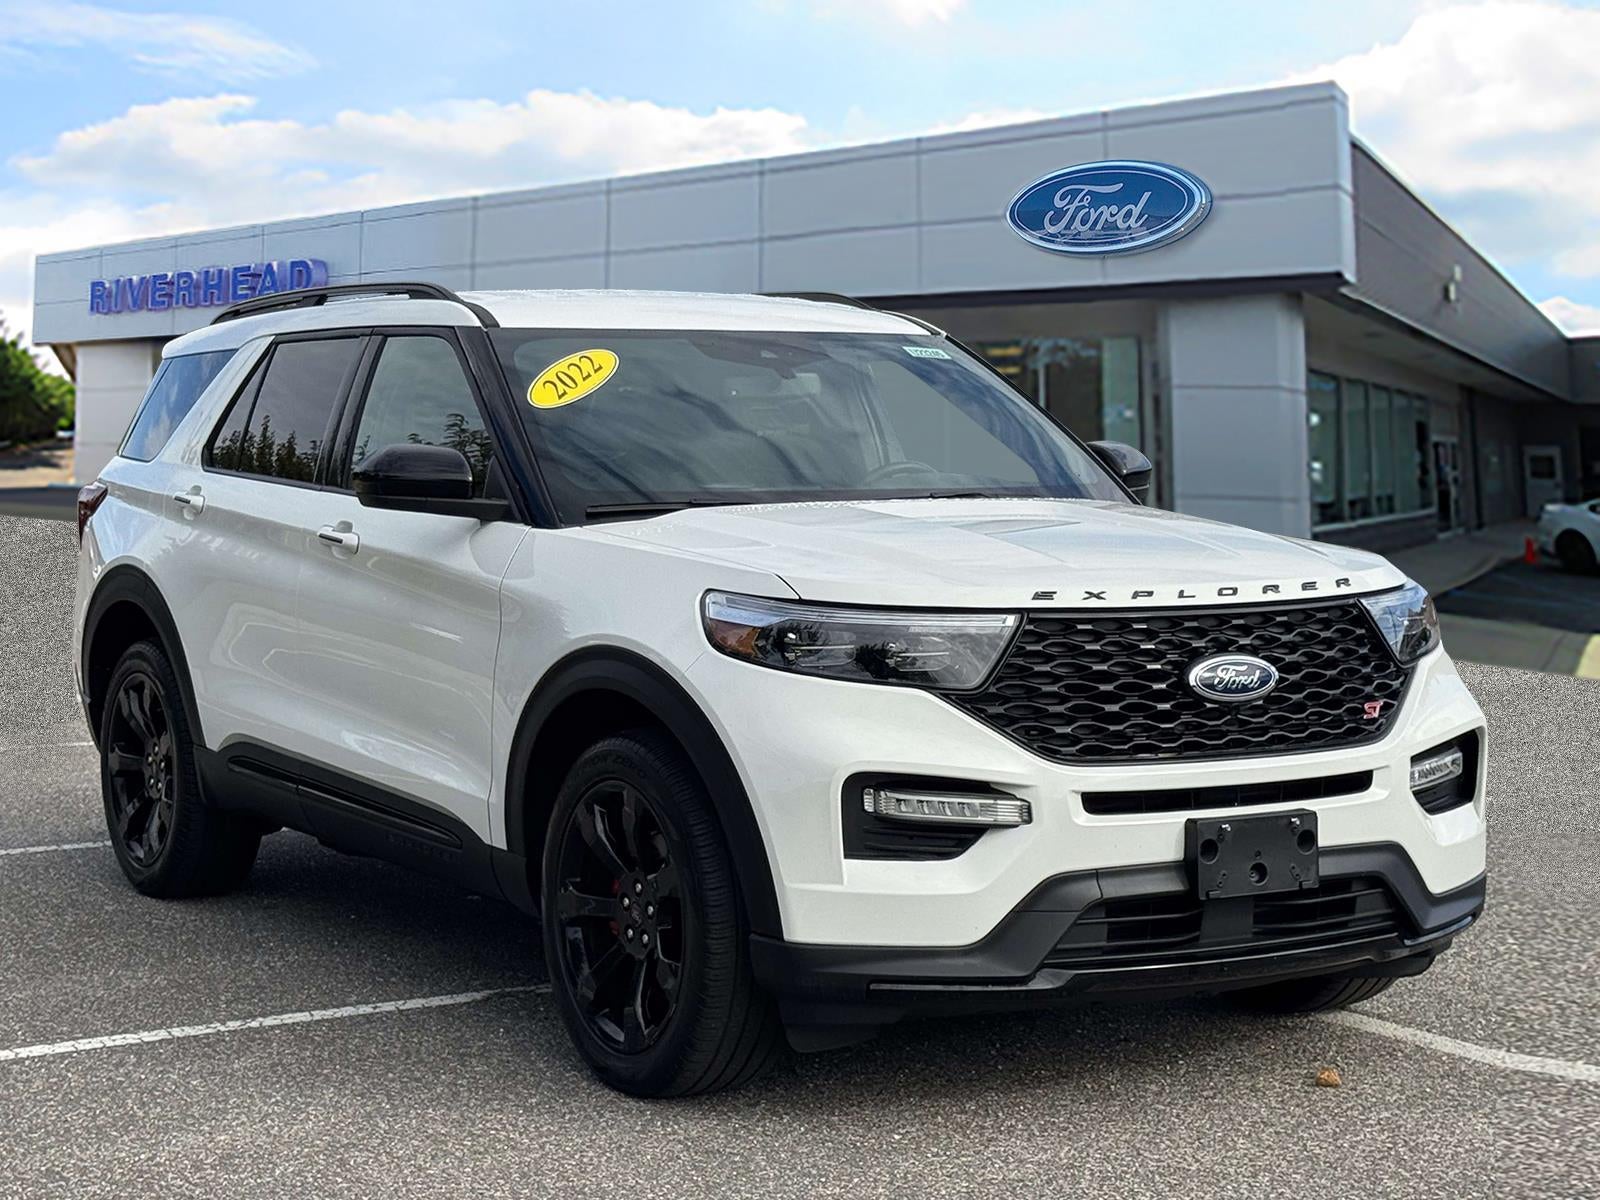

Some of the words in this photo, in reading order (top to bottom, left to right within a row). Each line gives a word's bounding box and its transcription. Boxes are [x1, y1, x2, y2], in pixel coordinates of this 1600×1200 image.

[1044, 182, 1153, 234] Ford
[89, 259, 325, 316] RIVERHEAD
[542, 355, 604, 401] 2022
[1031, 577, 1352, 601] EXPLORER
[1213, 664, 1261, 690] Ford
